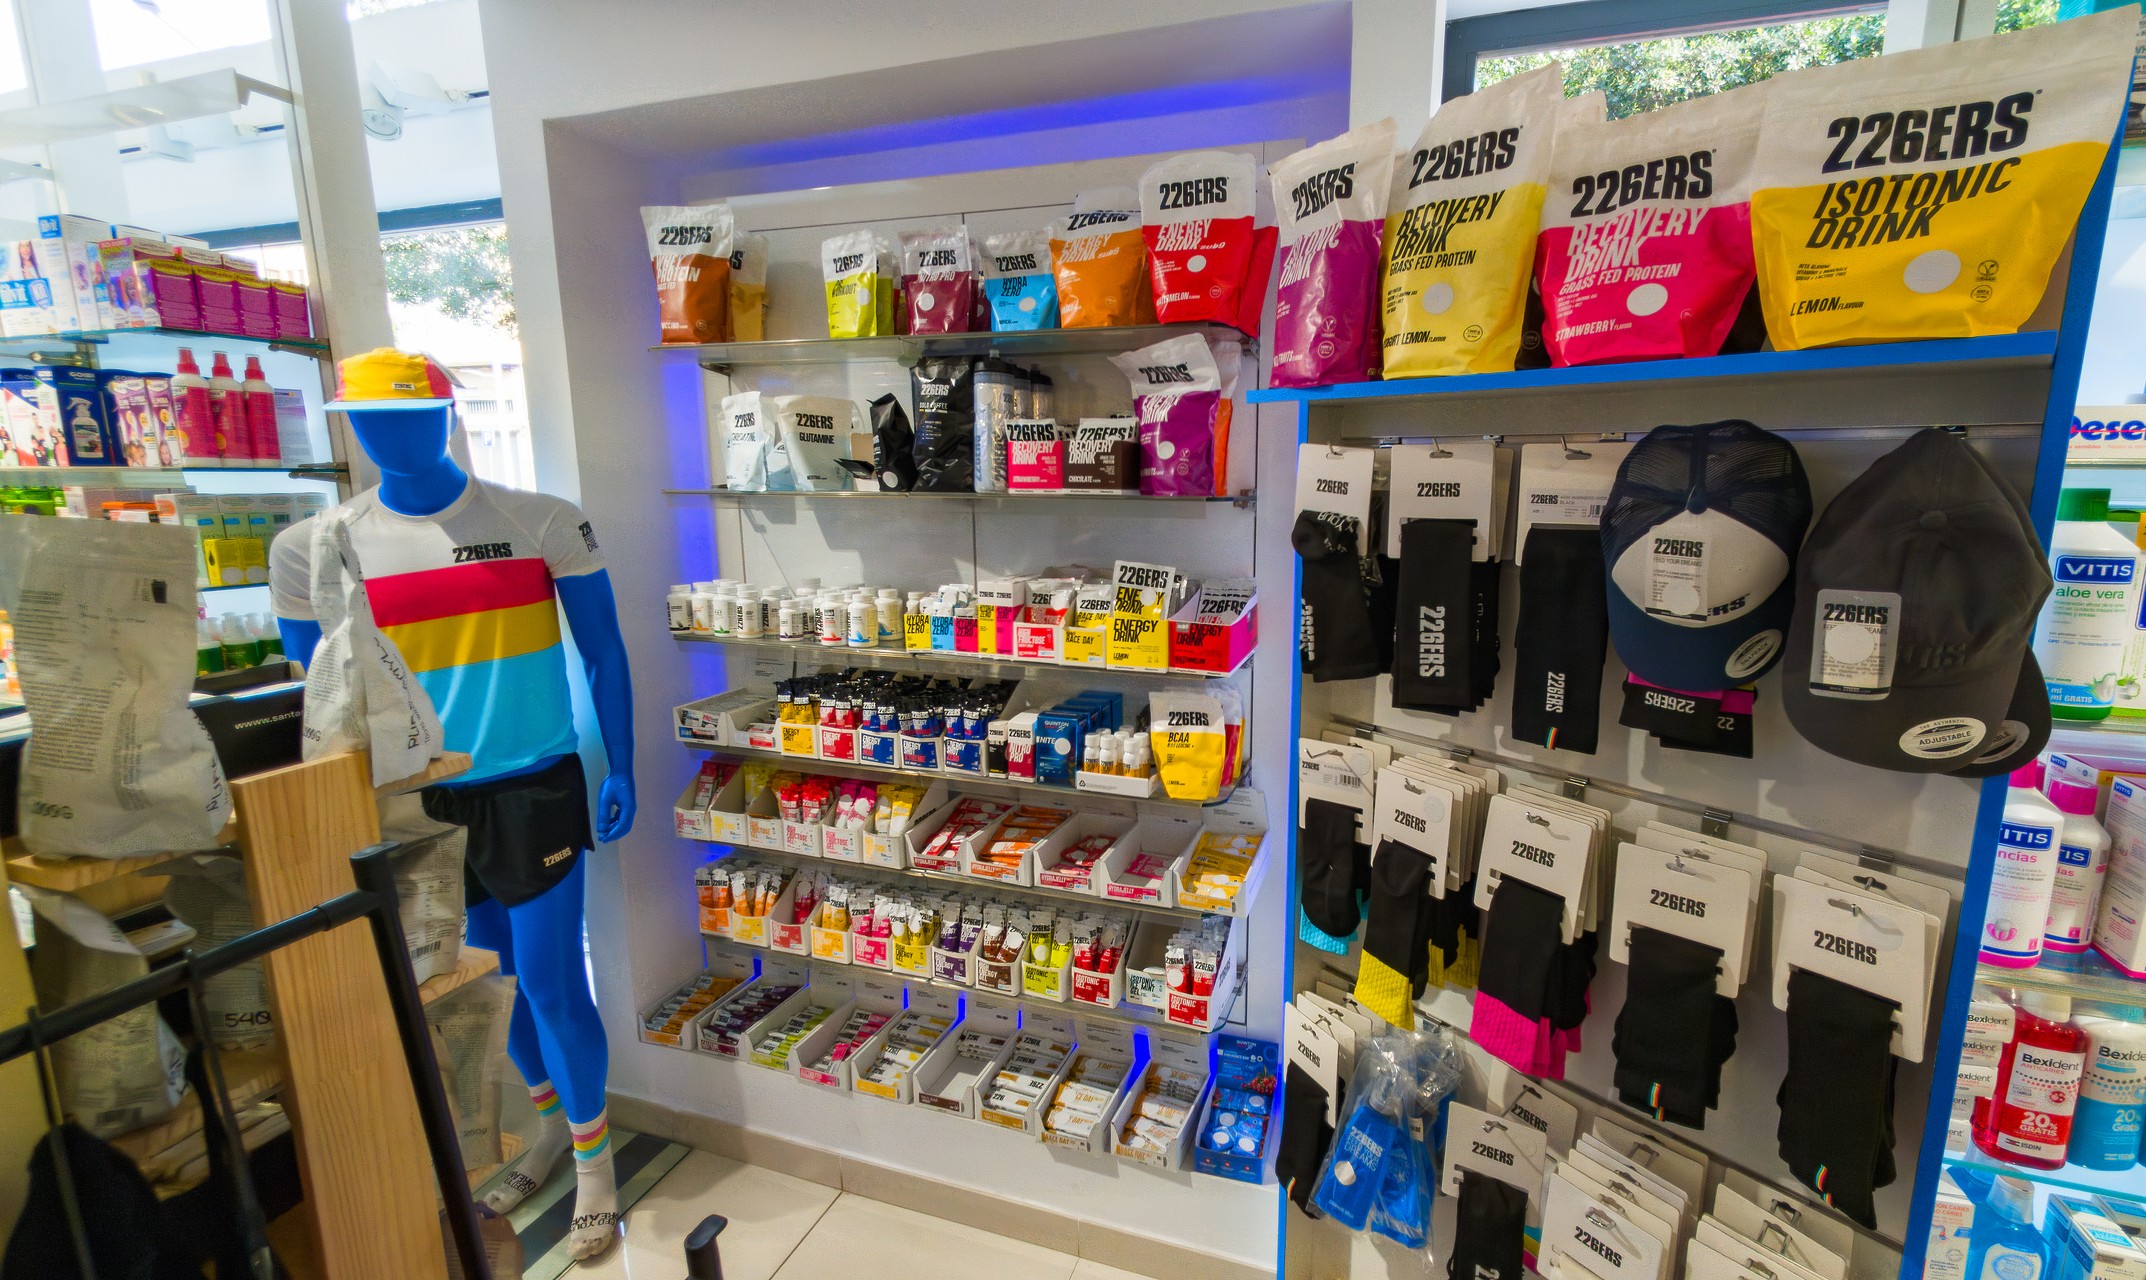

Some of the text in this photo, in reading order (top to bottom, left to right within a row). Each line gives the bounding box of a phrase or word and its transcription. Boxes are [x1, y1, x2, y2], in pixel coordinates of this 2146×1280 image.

[1822, 91, 2035, 174] 226ERS
[1409, 127, 1519, 190] 226ERS
[1570, 150, 1713, 218] 226ERS
[1812, 156, 2021, 219] ISOTONIC
[1159, 177, 1228, 210] 226ERS
[1292, 161, 1355, 223] 226ERS
[1397, 190, 1504, 237] RECOVERY
[1067, 212, 1132, 231] 226ERS
[1805, 202, 1946, 250] DRINK
[659, 226, 713, 246] 226ERS
[1157, 219, 1211, 240] ENERGY
[1567, 207, 1710, 257] RECOVERY
[1063, 233, 1112, 252] ENERGY
[1155, 237, 1225, 252] DRINK sub9
[1284, 221, 1345, 267] ISOTONIC
[1391, 224, 1455, 261] DRINK
[919, 250, 956, 268] 226ERS
[996, 254, 1036, 272] 226ERS
[1059, 247, 1120, 264] DRINK sub9
[1390, 250, 1476, 276] GRASS FED PROTEIN
[1564, 235, 1649, 284] DRINK
[833, 254, 864, 273] 226ERS
[940, 270, 955, 281] PRO
[1279, 254, 1314, 290] DRINK
[1559, 263, 1682, 296] GRASS FED PROTEIN
[1003, 276, 1028, 288] HYDRA
[1001, 286, 1021, 297] ZERO
[1790, 296, 1864, 316] LEMON FLAVOUR
[1401, 331, 1430, 344] LEMON
[1556, 318, 1616, 342] STRAWBERRY
[1139, 364, 1194, 384] 226ERS
[921, 384, 949, 396] 226ERS
[735, 412, 755, 428] 226ERS
[796, 413, 833, 430] 226ERS
[1141, 408, 1169, 425] DRINK
[800, 433, 835, 445] GLUTAMINE
[1007, 424, 1055, 441] 226ERS
[1012, 440, 1056, 453] RECOVERY
[1069, 439, 1114, 453] RECOVERY
[1012, 452, 1037, 465] DRINK
[1068, 451, 1095, 464] DRINK
[1316, 478, 1349, 496] 226ERS
[1417, 482, 1461, 498] 226ERS
[1531, 494, 1558, 505] 226ERS
[453, 542, 513, 563] 226ERS
[1654, 538, 1703, 558] 226ERS
[1681, 559, 1703, 567] DREAMS
[2065, 562, 2132, 577] VITIS
[1118, 565, 1169, 588] 226ERS
[2055, 585, 2124, 600] aloe vera
[1080, 600, 1110, 610] 226ERS
[1114, 600, 1144, 615] DRINK
[906, 615, 929, 625] HYDRA
[932, 616, 953, 625] HYDRA
[1093, 613, 1107, 621] DAY
[1823, 603, 1889, 624] 226ERS
[907, 624, 924, 634] ZERO
[932, 625, 949, 635] ZERO
[1113, 618, 1158, 633] ENERGY
[1066, 634, 1094, 645] RACE DAY
[1113, 629, 1140, 643] DRINK
[1176, 632, 1204, 646] DRINK
[1420, 605, 1445, 678] 226ERS
[1740, 642, 1769, 666] SNAPBACK
[1545, 671, 1566, 713] 226ERS
[2064, 695, 2093, 703] GRATIS
[1645, 690, 1696, 714] 226ERS
[1168, 711, 1209, 726] 226ERS
[1934, 719, 1965, 727] AUTHENTIC
[1009, 729, 1031, 738] 226ERS
[1168, 732, 1189, 742] BCAA
[1919, 731, 1971, 746] ADJUSTABLE
[1009, 743, 1031, 754] NITRO
[1009, 752, 1024, 762] PRO
[2051, 755, 2067, 767] VITIS
[1301, 760, 1320, 771] 226ERS
[2115, 784, 2131, 796] VITIS
[1395, 808, 1427, 834] 226ERS
[2001, 827, 2048, 844] ITIS
[543, 847, 572, 868] 226ERS
[1511, 840, 1556, 868] 226ERS
[1109, 884, 1134, 894] HYDRAJELLY
[1650, 888, 1706, 919] 226ERS
[1814, 930, 1877, 966] 226ERS
[935, 959, 954, 970] ENERGY
[935, 966, 944, 974] GEL
[1025, 966, 1049, 978] ISOTONIC
[1195, 961, 1216, 972] 226ERS
[979, 969, 998, 979] ENERGY
[1026, 973, 1035, 981] GEL
[1075, 974, 1100, 985] ISOTONIC
[1130, 975, 1155, 985] ISOTONIC
[1075, 981, 1086, 989] GEL
[1130, 988, 1141, 996] GEL
[1170, 995, 1196, 1008] ISOTONIC
[1171, 1002, 1181, 1011] GEL
[1967, 1014, 2008, 1026] Bexident
[1297, 1040, 1321, 1068] 226ERS
[2020, 1062, 2065, 1075] ANTICARIES
[2021, 1053, 2080, 1071] Bexident
[1510, 1103, 1548, 1132] 226ERS
[2021, 1111, 2058, 1130] 20%
[2019, 1124, 2057, 1137] GRATIS
[1059, 1137, 1070, 1145] DAY
[1350, 1125, 1383, 1158] 226ERS
[2020, 1143, 2041, 1151] ISDIN
[1472, 1140, 1514, 1167] 226ERS
[1574, 1226, 1622, 1268] 226ERS
